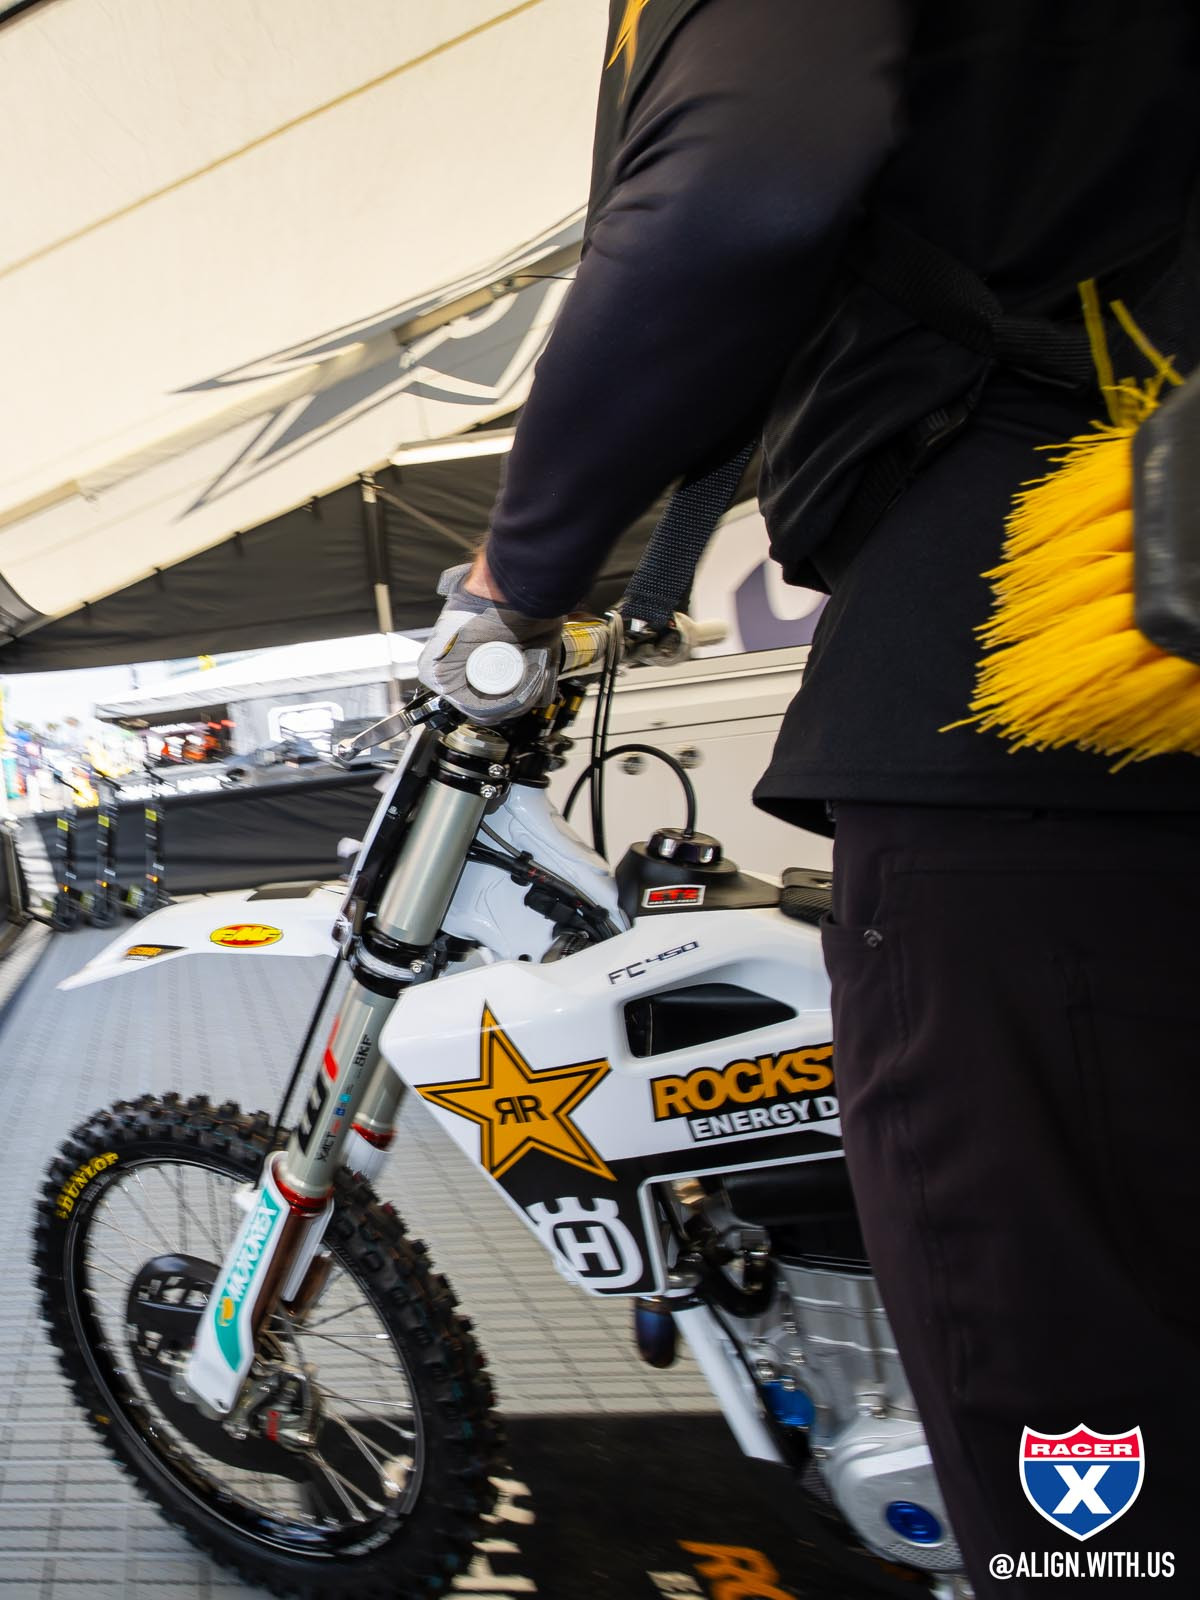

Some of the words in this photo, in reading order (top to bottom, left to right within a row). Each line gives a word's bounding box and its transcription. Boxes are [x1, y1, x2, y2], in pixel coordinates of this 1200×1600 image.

[211, 926, 282, 942] FMF
[608, 962, 646, 985] FC
[646, 941, 699, 963] 450
[652, 1045, 834, 1119] ROCKS
[691, 1098, 811, 1140] ENERGY
[57, 1152, 119, 1212] DUNLOP
